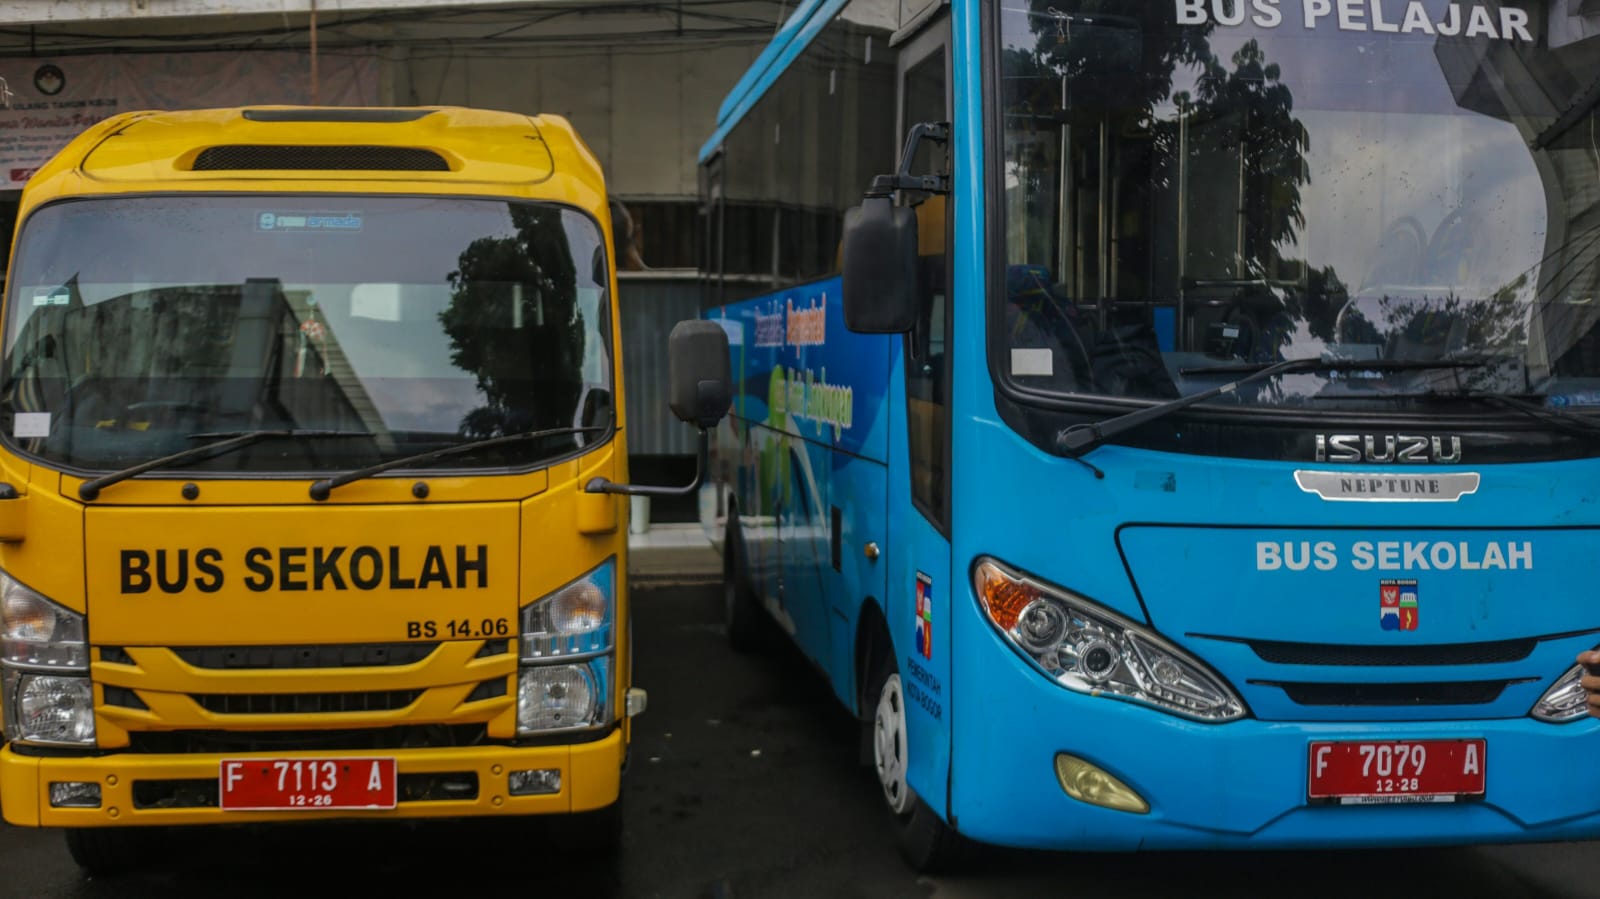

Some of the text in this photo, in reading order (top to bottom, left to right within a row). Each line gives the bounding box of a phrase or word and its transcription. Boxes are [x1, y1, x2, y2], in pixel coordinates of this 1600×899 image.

[1176, 0, 1533, 42] BUS PELAJAR
[1315, 433, 1462, 463] ISUZU
[1341, 479, 1440, 494] NEPTUNE
[120, 545, 488, 594] BUS SEKOLAH
[1256, 541, 1533, 571] BUS SEKOLAH
[407, 618, 509, 638] BS 14.06
[1316, 743, 1479, 778] F 7079 A
[227, 761, 382, 792] F 7113 A
